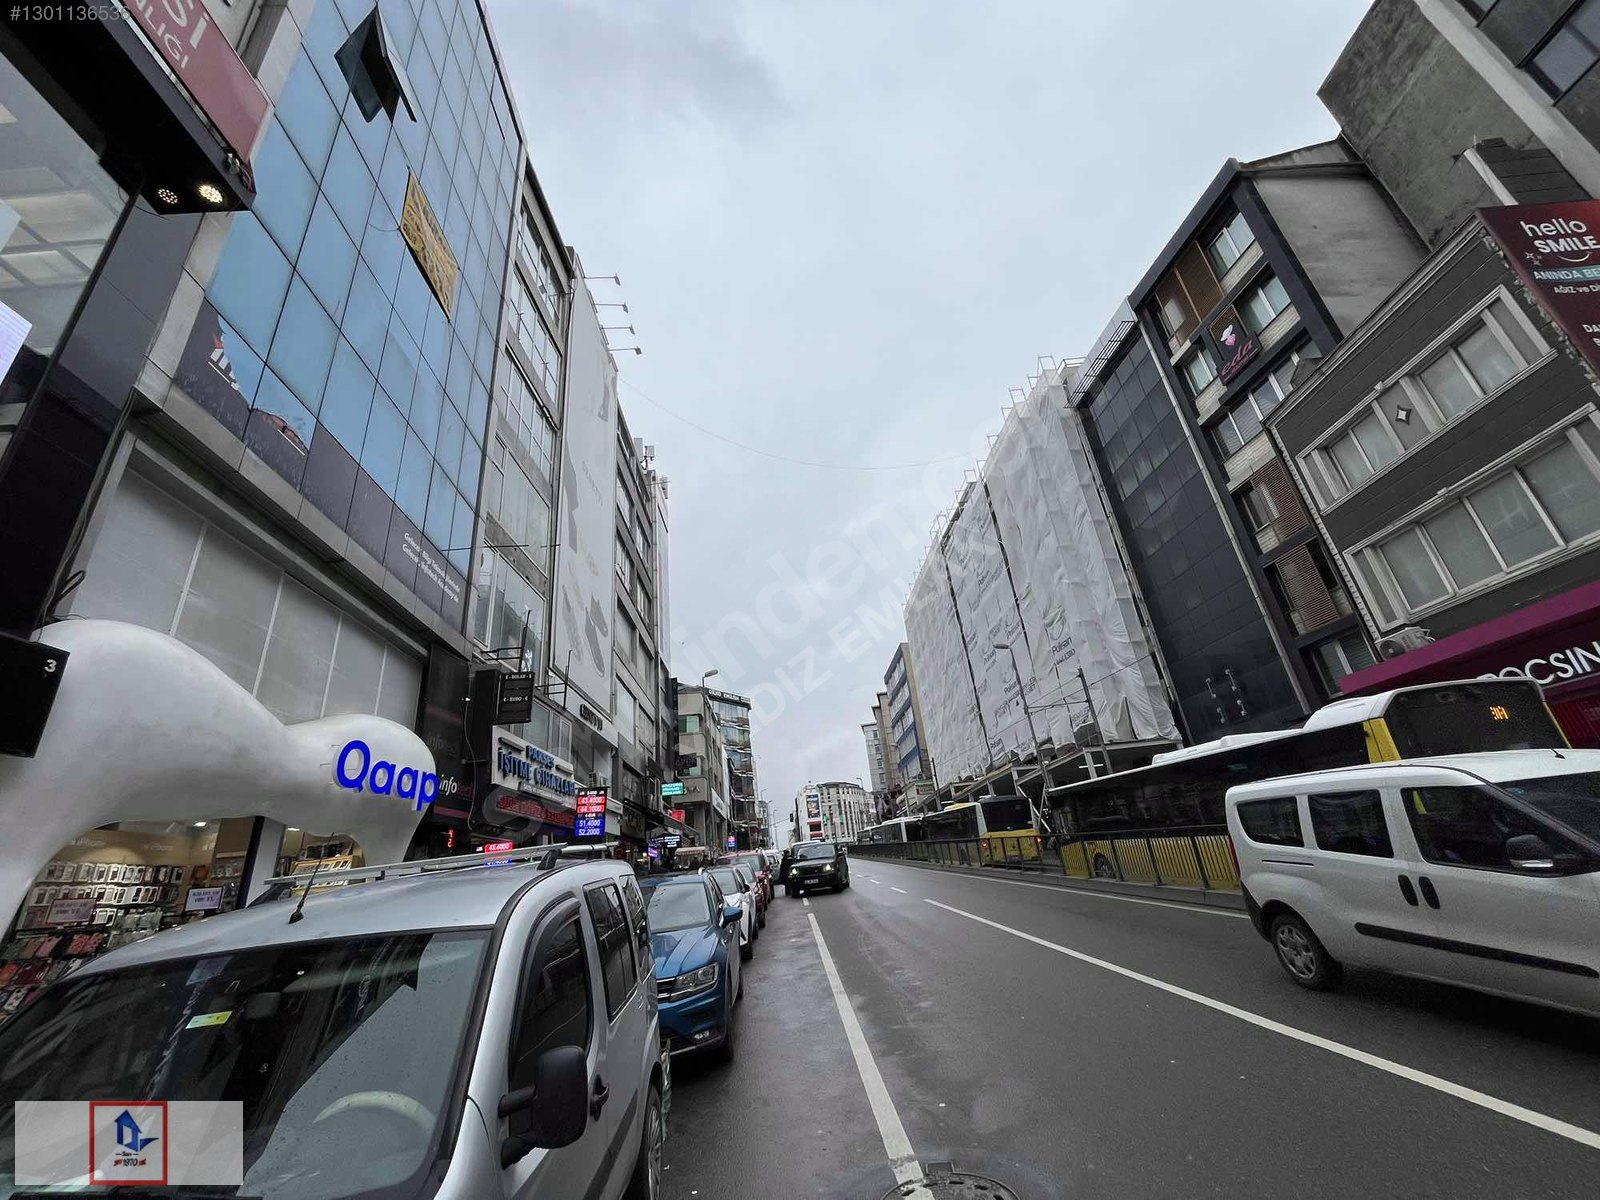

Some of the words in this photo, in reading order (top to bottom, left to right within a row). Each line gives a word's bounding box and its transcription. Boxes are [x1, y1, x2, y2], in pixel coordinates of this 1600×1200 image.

[1520, 218, 1587, 237] hello
[1534, 235, 1600, 253] SMILE
[1533, 269, 1583, 281] ANINDA
[44, 658, 57, 672] 3
[1476, 641, 1600, 685] CSIN
[336, 739, 440, 812] Qaap
[579, 819, 601, 827] 51.4000
[578, 828, 600, 836] 52.2000
